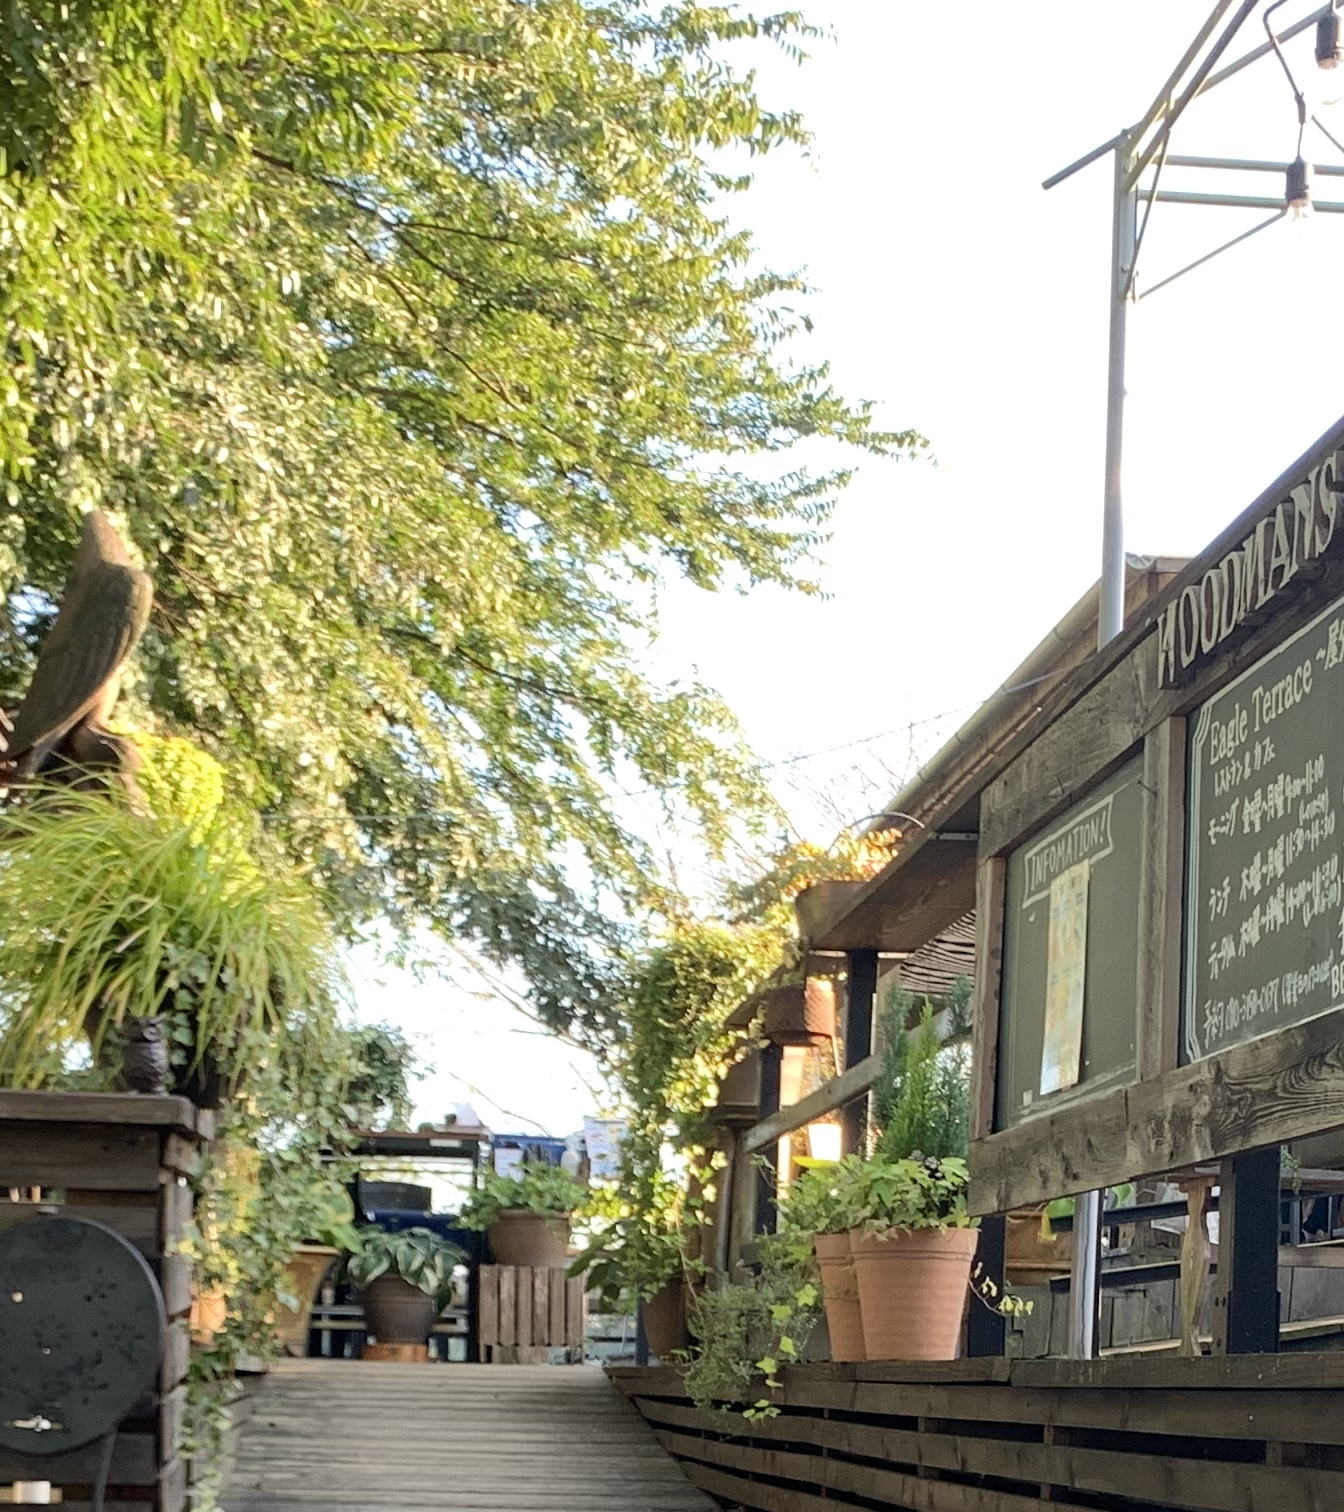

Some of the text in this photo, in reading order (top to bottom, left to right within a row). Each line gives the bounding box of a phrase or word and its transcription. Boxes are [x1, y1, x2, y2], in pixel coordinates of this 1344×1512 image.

[1157, 456, 1338, 690] WOODMANS
[1209, 702, 1249, 766] Eagle
[1251, 658, 1314, 734] Terrace
[1030, 810, 1107, 892] INFOMATION!
[1208, 875, 1231, 922] ランチ
